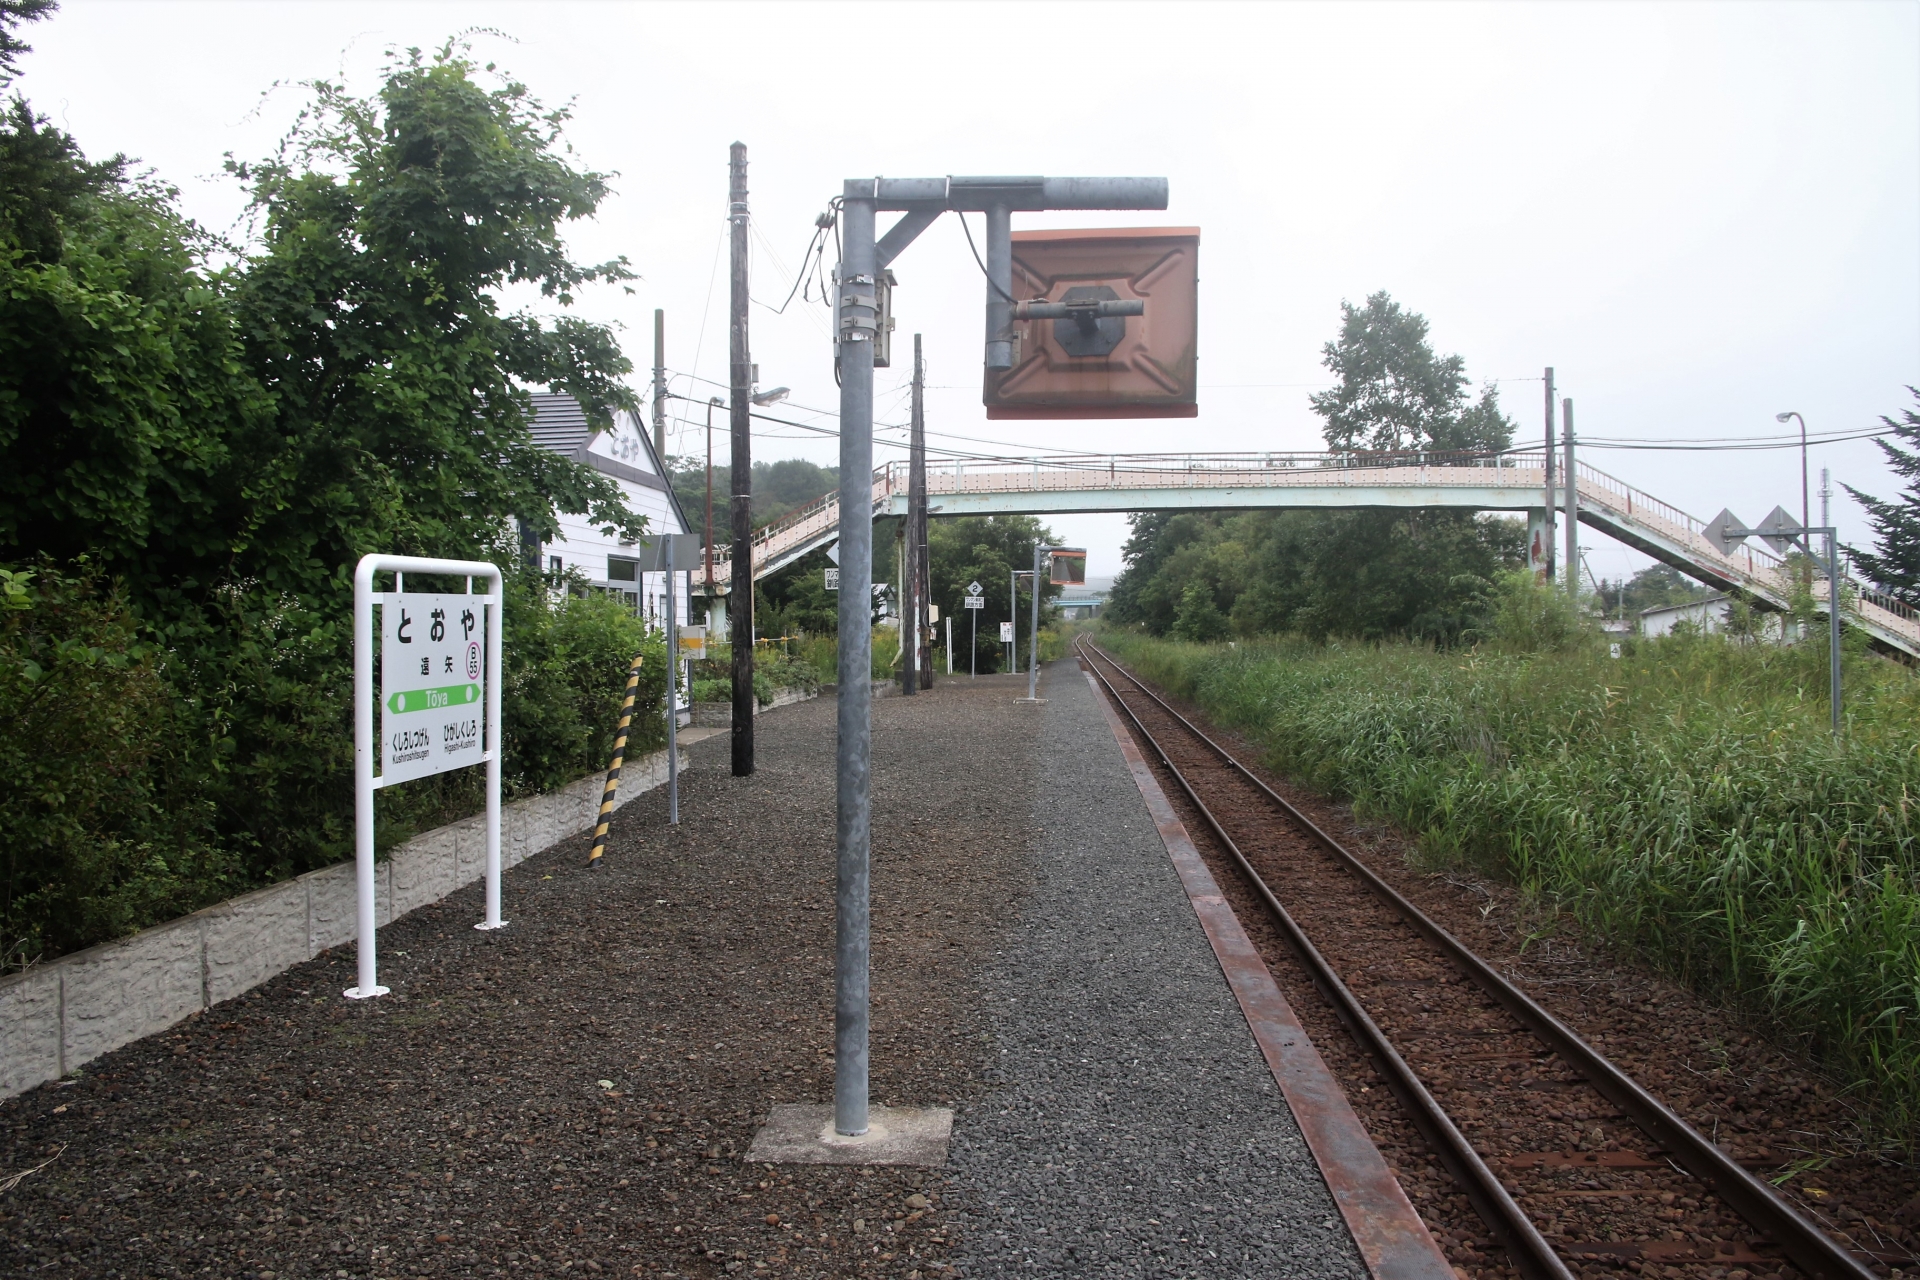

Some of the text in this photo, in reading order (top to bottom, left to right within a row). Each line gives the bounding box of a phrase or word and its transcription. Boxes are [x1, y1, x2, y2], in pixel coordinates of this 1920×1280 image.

[972, 585, 978, 593] 2
[398, 608, 474, 644] とおや
[471, 646, 476, 660] B
[421, 655, 453, 676] 遠矢
[469, 661, 477, 674] 55
[425, 690, 448, 708] Tōya
[444, 720, 476, 742] ひがしくしろ
[393, 728, 429, 752] くしろしつげん
[444, 740, 476, 754] Higashi-Kushiro
[393, 750, 429, 764] Kushiroshitsugen
